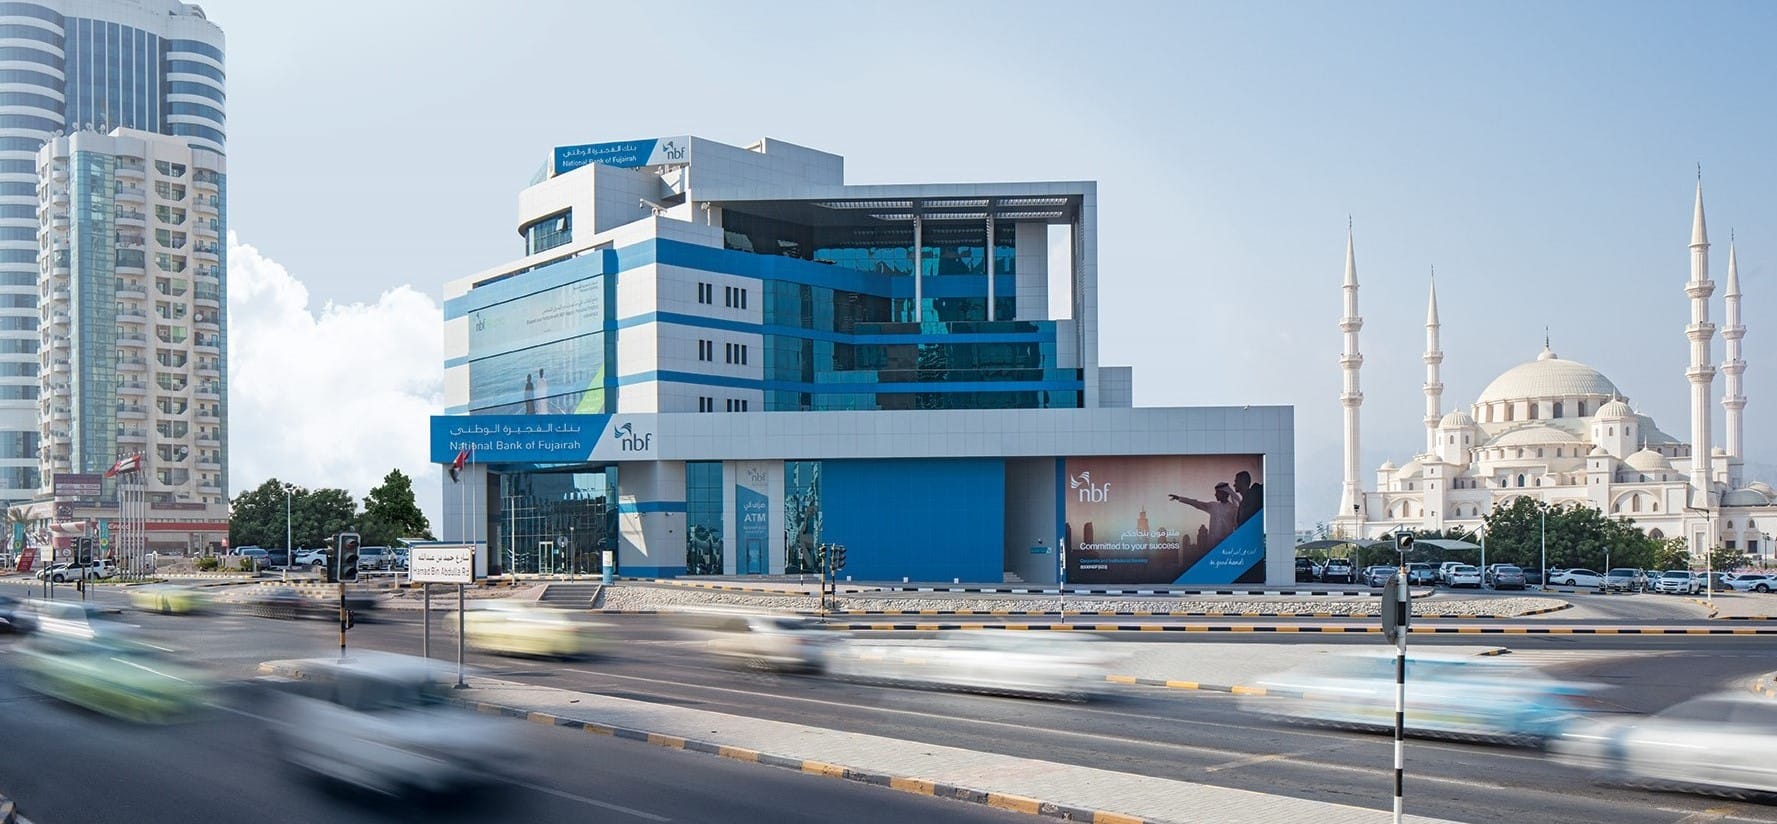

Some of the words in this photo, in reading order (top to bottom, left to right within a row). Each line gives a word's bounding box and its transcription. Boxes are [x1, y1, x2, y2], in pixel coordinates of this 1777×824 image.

[621, 144, 637, 152] بنك
[667, 147, 686, 160] nbf
[612, 155, 637, 165] Fujairah
[449, 423, 500, 436] الوطني
[502, 423, 553, 436] الفجيرة
[554, 423, 581, 433] بنك
[449, 441, 493, 451] National
[496, 440, 522, 450] Bank
[525, 440, 536, 450] of
[538, 440, 581, 452] Fujairah
[622, 433, 652, 452] nbf
[1080, 482, 1111, 502] nbf
[744, 513, 766, 522] ATM
[1079, 542, 1121, 551] Committed
[1130, 544, 1148, 552] your
[456, 552, 469, 564] شارع
[414, 566, 430, 576] Hamad
[431, 566, 440, 576] Bin
[462, 566, 469, 577] Rd
